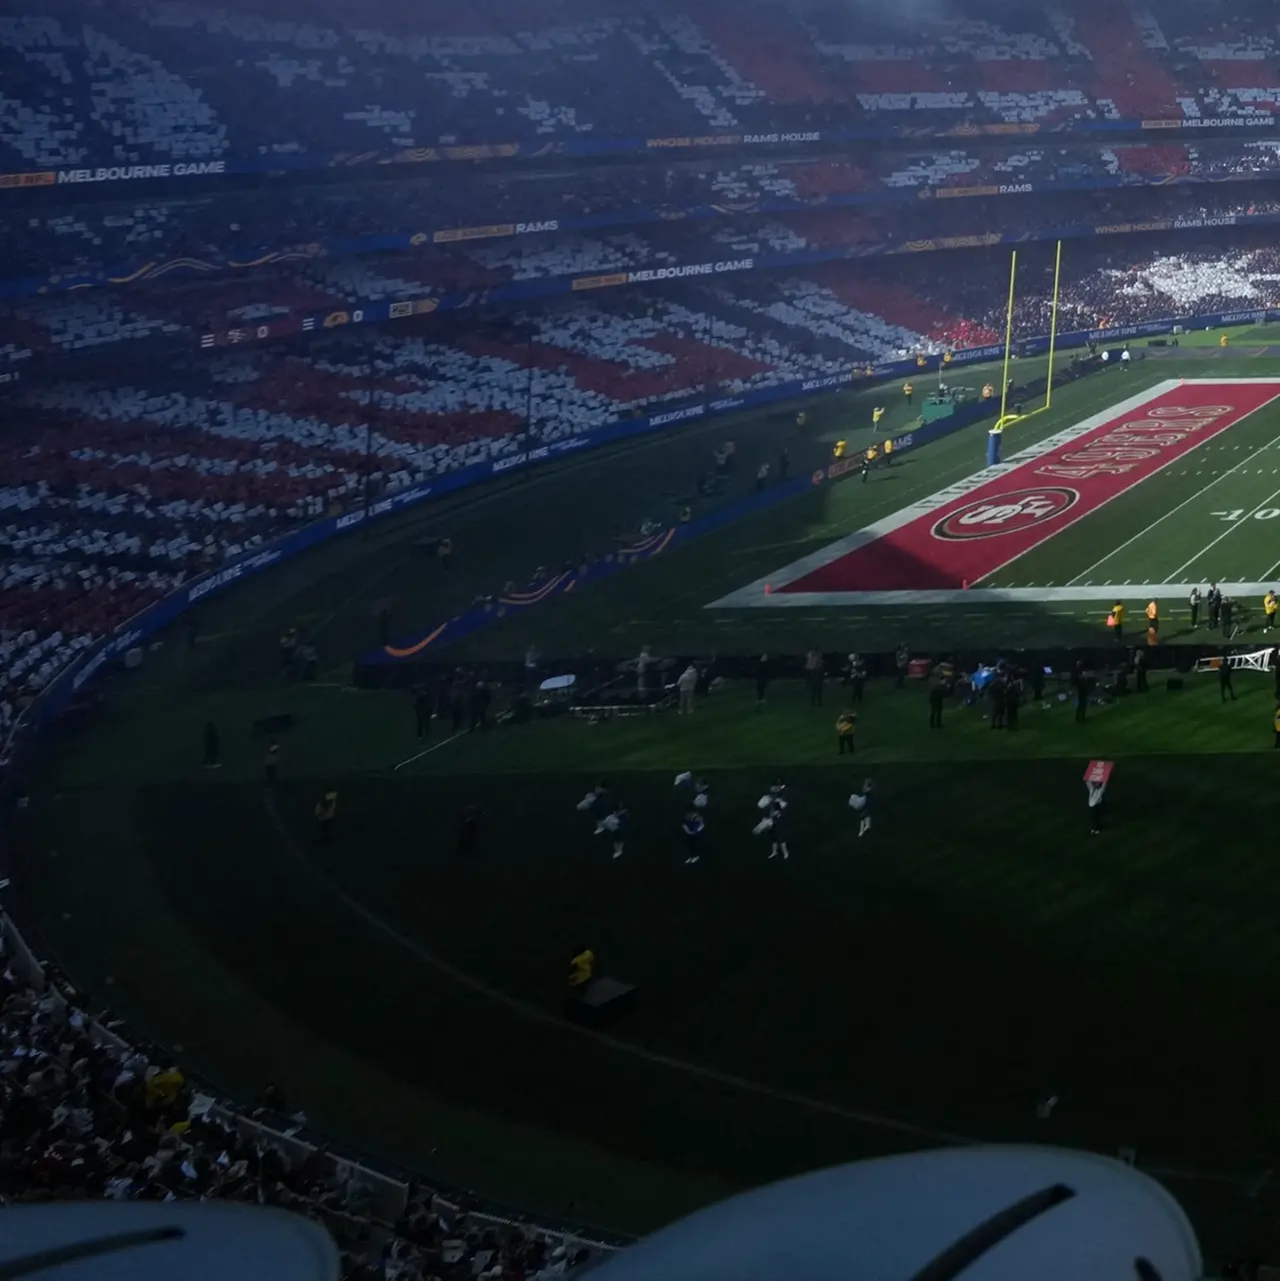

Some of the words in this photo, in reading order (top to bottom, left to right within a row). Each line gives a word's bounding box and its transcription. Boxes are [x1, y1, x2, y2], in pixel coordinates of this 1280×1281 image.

[1182, 118, 1244, 128] MELBOURNE
[1245, 117, 1275, 126] GAME
[743, 134, 779, 143] RAMS
[781, 131, 820, 142] HOUSE
[58, 165, 170, 183] MELBOURNE
[173, 161, 225, 175] GAME
[1000, 184, 1033, 193] RAMS
[516, 220, 559, 234] RAMS
[1174, 219, 1202, 229] RAMS
[1204, 217, 1236, 227] HOUSE
[628, 263, 713, 282] MELBOURNE
[715, 259, 754, 272] GAME
